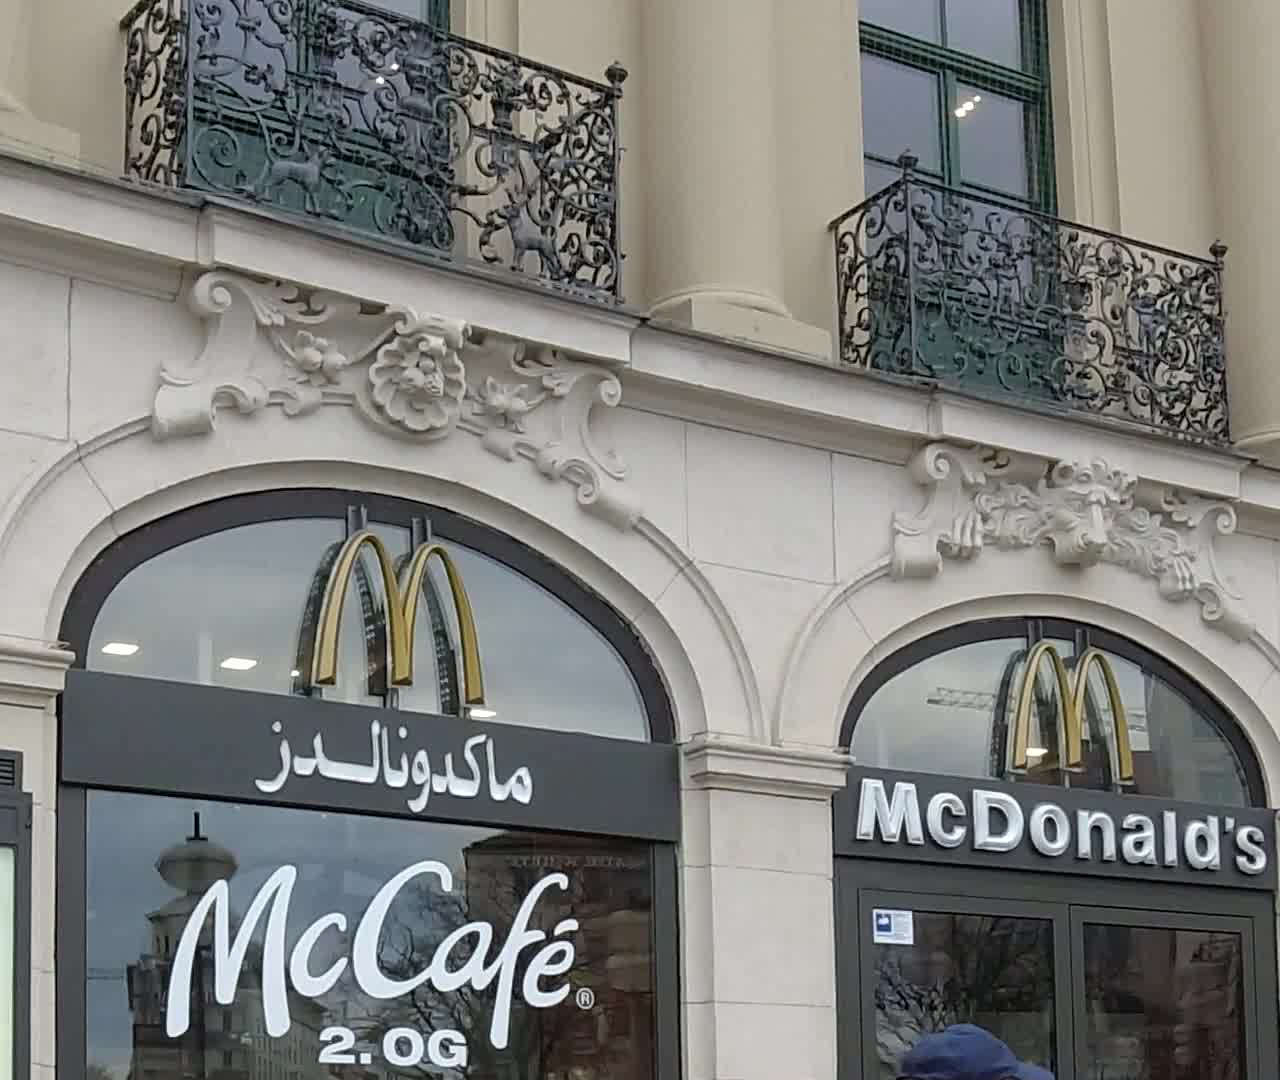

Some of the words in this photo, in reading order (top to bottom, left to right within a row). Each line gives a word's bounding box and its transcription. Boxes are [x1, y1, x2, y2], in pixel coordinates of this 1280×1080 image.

[255, 720, 533, 812] ماكدونالدز
[856, 778, 1267, 875] McDonald's
[166, 860, 579, 1050] McCafé
